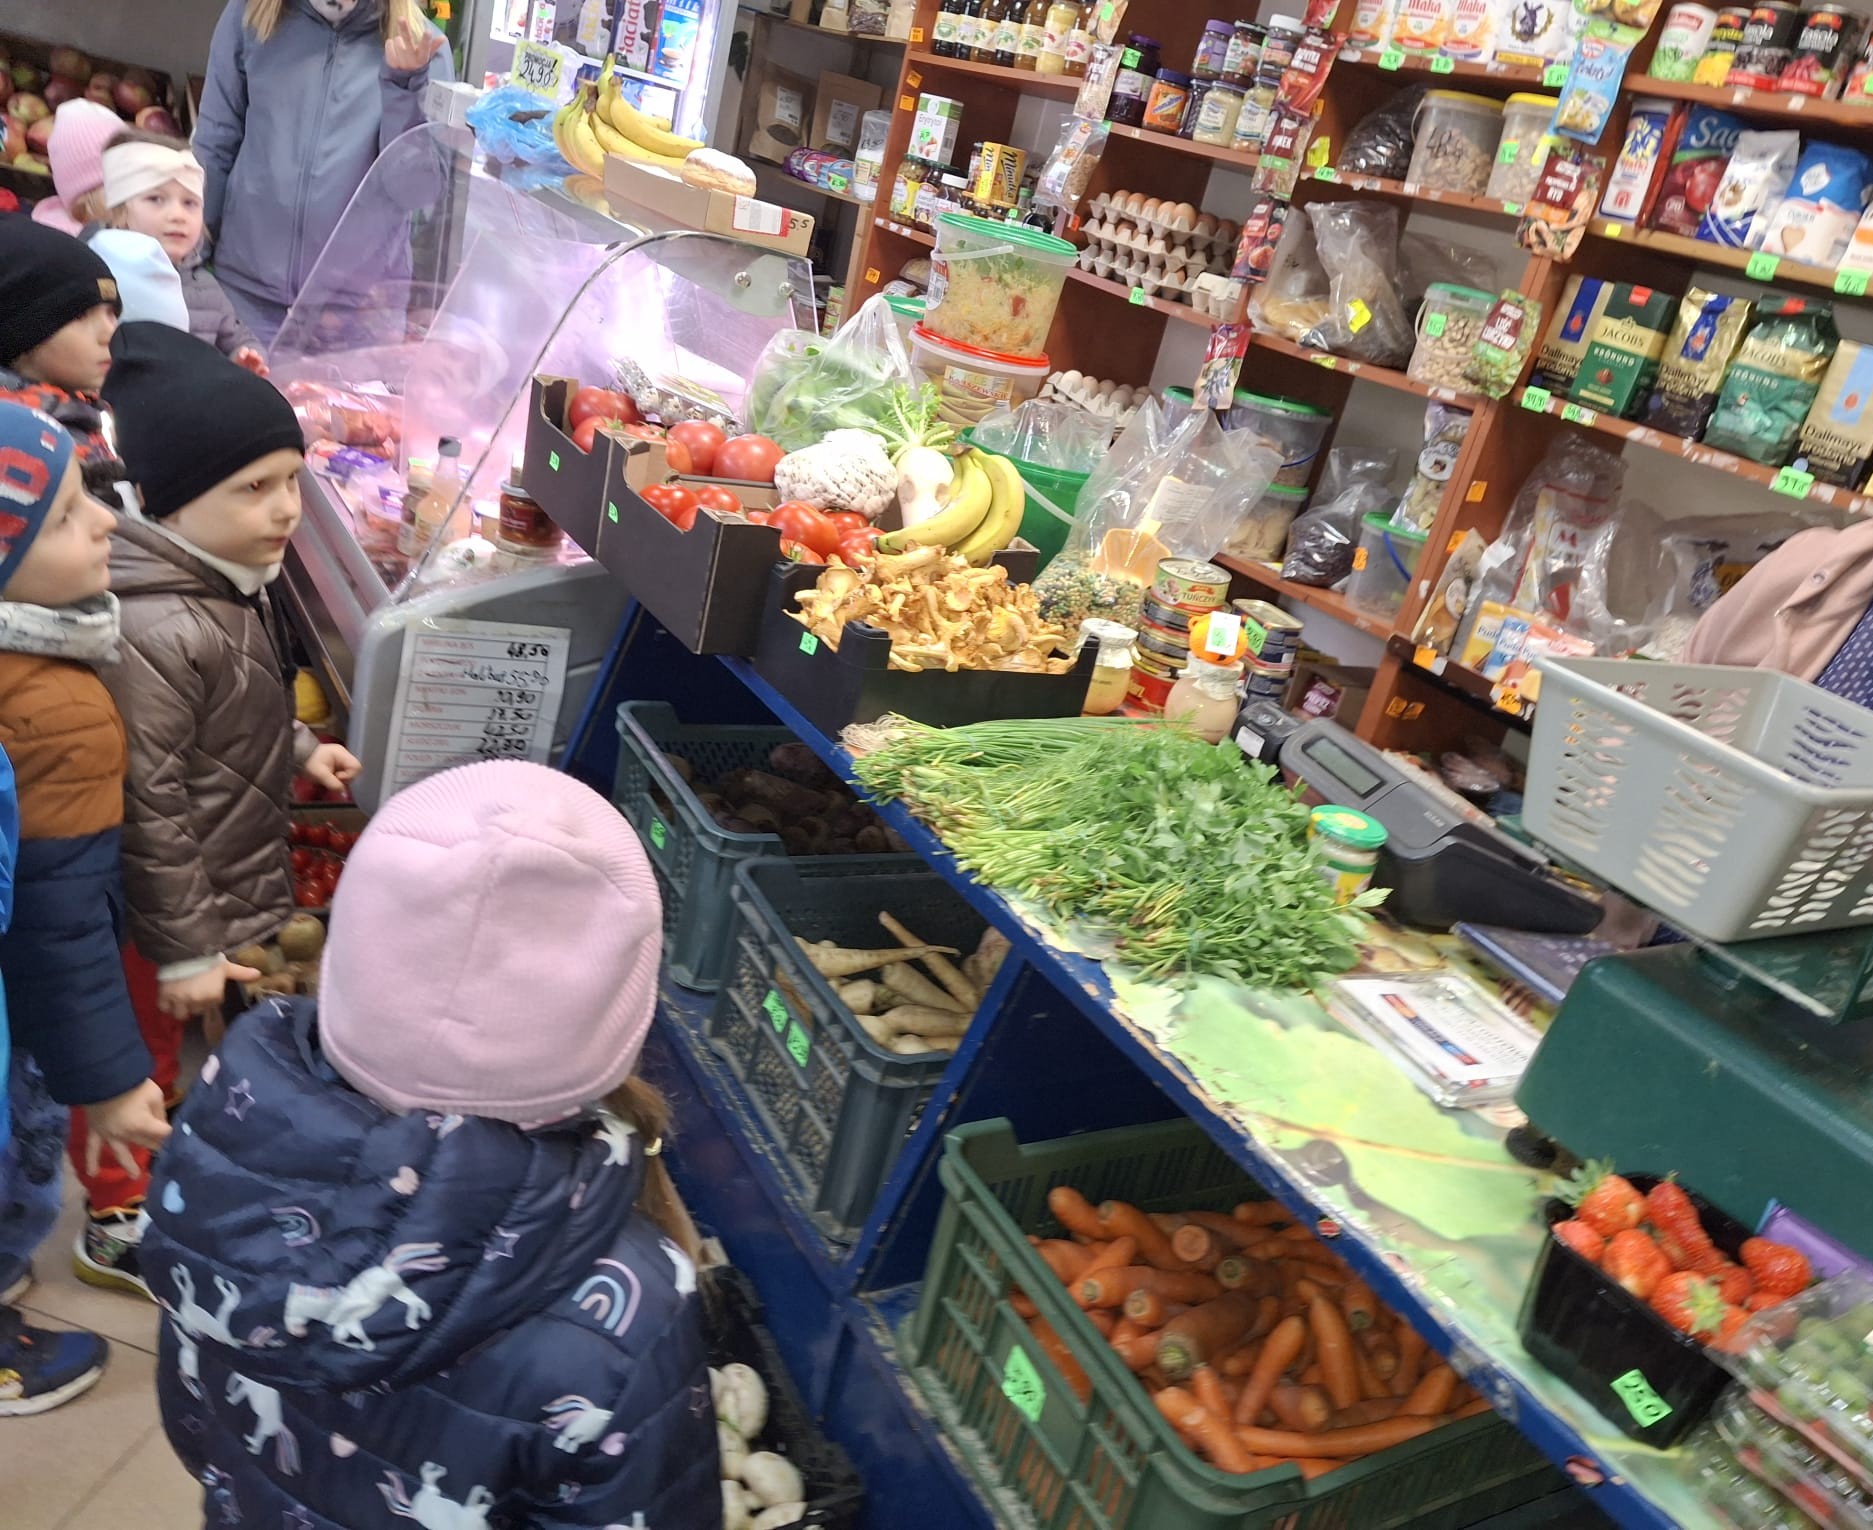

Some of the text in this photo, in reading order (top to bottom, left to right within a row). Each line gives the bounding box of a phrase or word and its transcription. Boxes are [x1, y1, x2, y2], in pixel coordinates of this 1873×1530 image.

[1001, 151, 1018, 199] Minutka
[1602, 326, 1645, 347] JACOBS
[1594, 347, 1636, 365] KRÖNUNG
[1804, 424, 1864, 450] Dallmayr
